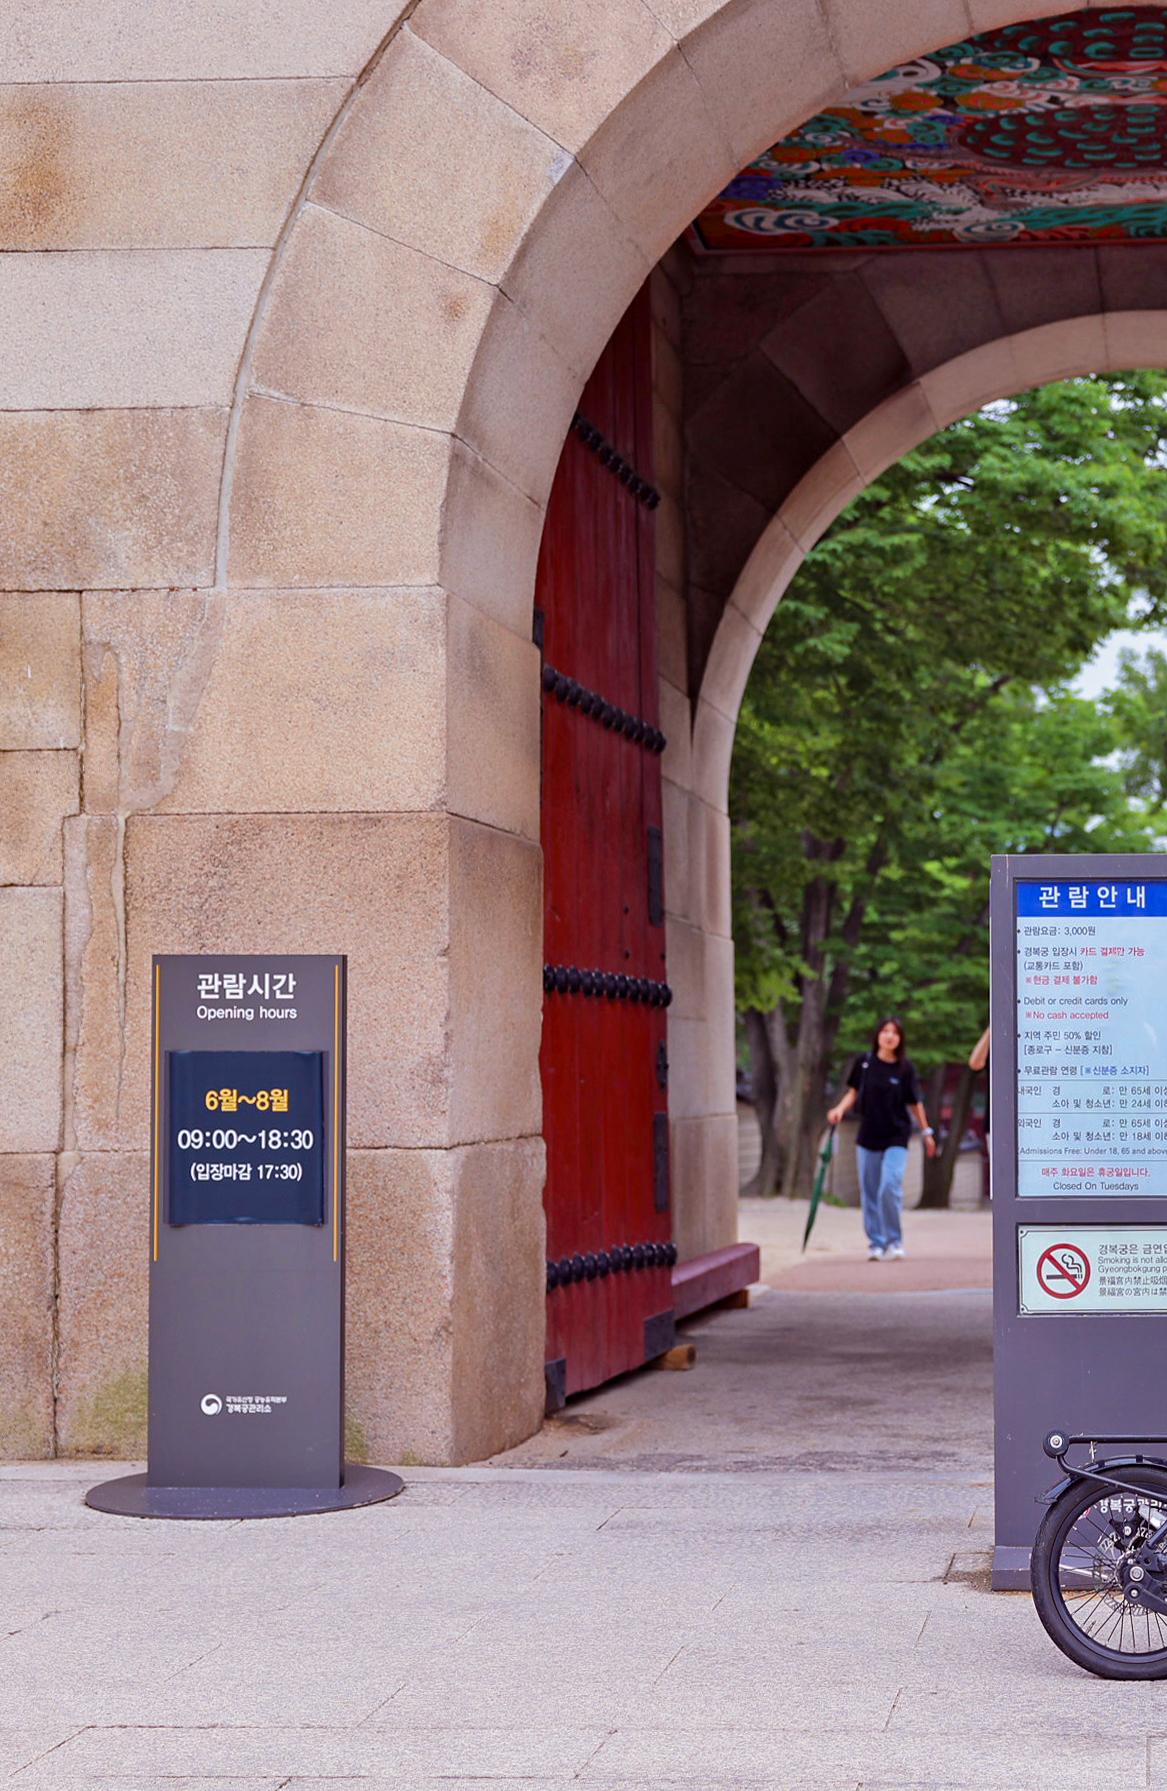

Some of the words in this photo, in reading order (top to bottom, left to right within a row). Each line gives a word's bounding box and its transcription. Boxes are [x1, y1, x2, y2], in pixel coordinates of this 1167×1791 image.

[1024, 926, 1061, 936] 관람요금:
[1064, 926, 1096, 936] 3,000원
[1024, 947, 1049, 956] 경복궁
[1052, 947, 1077, 956] 입장시
[1080, 947, 1097, 956] 카드
[1100, 947, 1125, 956] 결제만
[1128, 947, 1145, 956] 가능
[1024, 961, 1060, 971] (교통카드
[1063, 961, 1083, 971] 포함)
[1054, 976, 1069, 985] 결제
[197, 973, 296, 1000] 관람시간
[1024, 997, 1045, 1005] Debit
[1059, 997, 1082, 1005] credit
[1085, 997, 1108, 1005] cards
[1111, 997, 1128, 1006] only
[197, 1006, 254, 1021] Opening
[259, 1006, 297, 1019] hours
[1070, 1011, 1109, 1020] accepted
[1024, 1031, 1041, 1040] 지역
[1044, 1031, 1060, 1040] 주민
[1064, 1031, 1081, 1040] 50%
[1085, 1031, 1101, 1040] 할인
[1065, 1045, 1089, 1055] 신분증
[1024, 1066, 1057, 1075] 무료관람
[1061, 1066, 1077, 1075] 연령
[1121, 1066, 1149, 1075] 소지자]
[1119, 1086, 1127, 1095] 만
[1131, 1086, 1150, 1095] 65세
[1052, 1100, 1069, 1109] 소아
[1073, 1100, 1081, 1109] 및
[1086, 1100, 1115, 1109] 청소년:
[1119, 1100, 1127, 1109] 만
[1131, 1100, 1150, 1109] 24세
[1119, 1119, 1127, 1128] 만
[1131, 1119, 1150, 1128] 65세
[1052, 1132, 1069, 1141] 소아
[1073, 1132, 1081, 1141] 및
[1086, 1132, 1115, 1141] 청소년:
[1120, 1132, 1127, 1141] 만
[1132, 1132, 1150, 1141] 18세
[1108, 1148, 1119, 1156] 18,
[190, 1163, 252, 1181] (입장마감
[257, 1163, 303, 1181] 17:30)
[1042, 1167, 1058, 1177] 매주
[1062, 1167, 1094, 1177] 화요일은
[1053, 1182, 1082, 1191] Closed
[1085, 1182, 1097, 1191] On
[1100, 1182, 1139, 1191] Tuesdays
[1099, 1244, 1138, 1255] 경복궁은
[1098, 1256, 1130, 1265] Smoking
[1098, 1265, 1160, 1274] Gyeongbokgung
